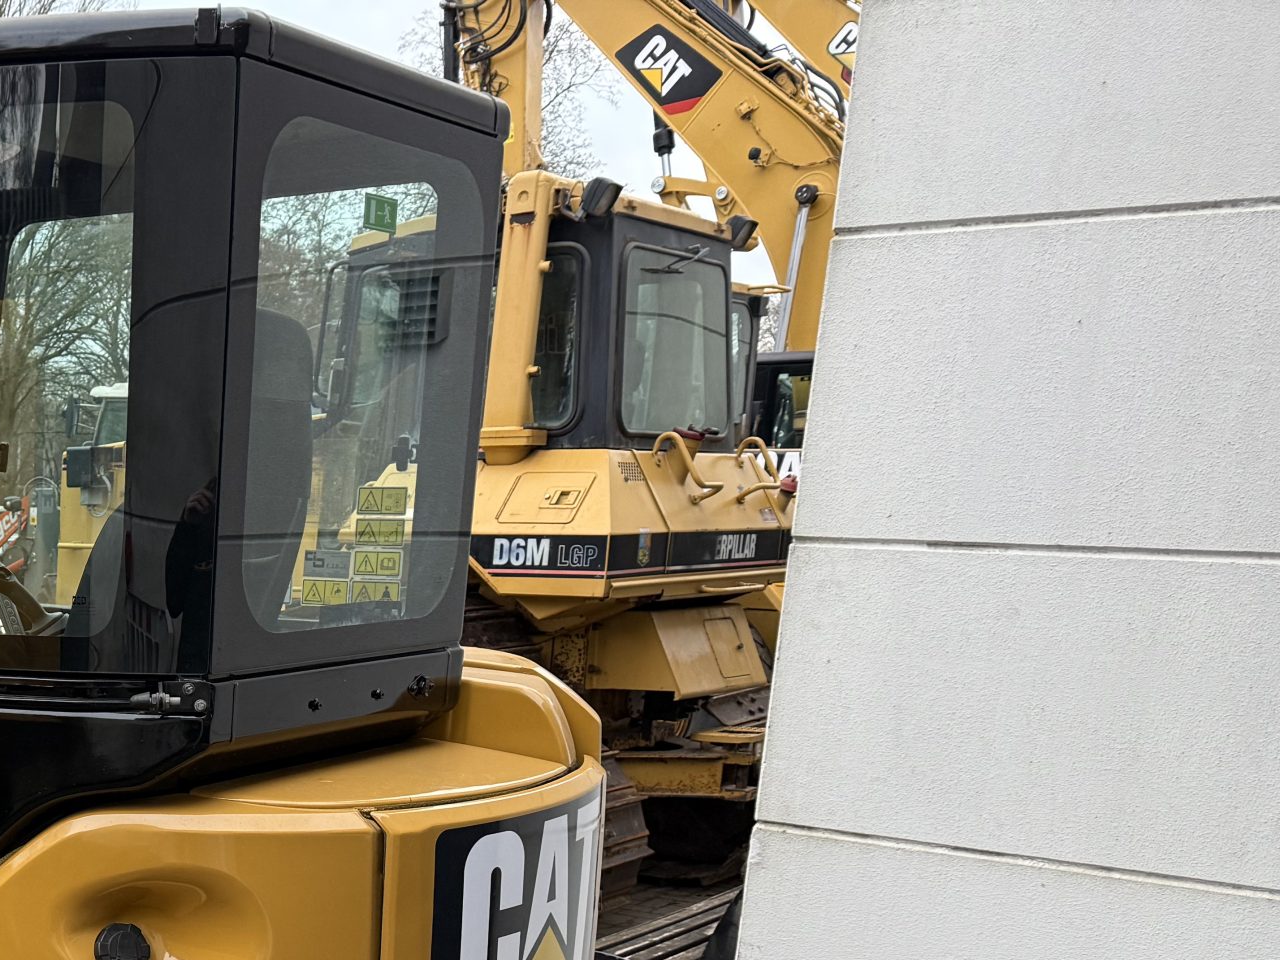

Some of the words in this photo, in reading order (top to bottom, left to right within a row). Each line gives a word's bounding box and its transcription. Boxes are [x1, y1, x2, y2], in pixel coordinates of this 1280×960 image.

[634, 34, 693, 97] CAT
[492, 537, 551, 566] D6M
[557, 544, 598, 567] LGP
